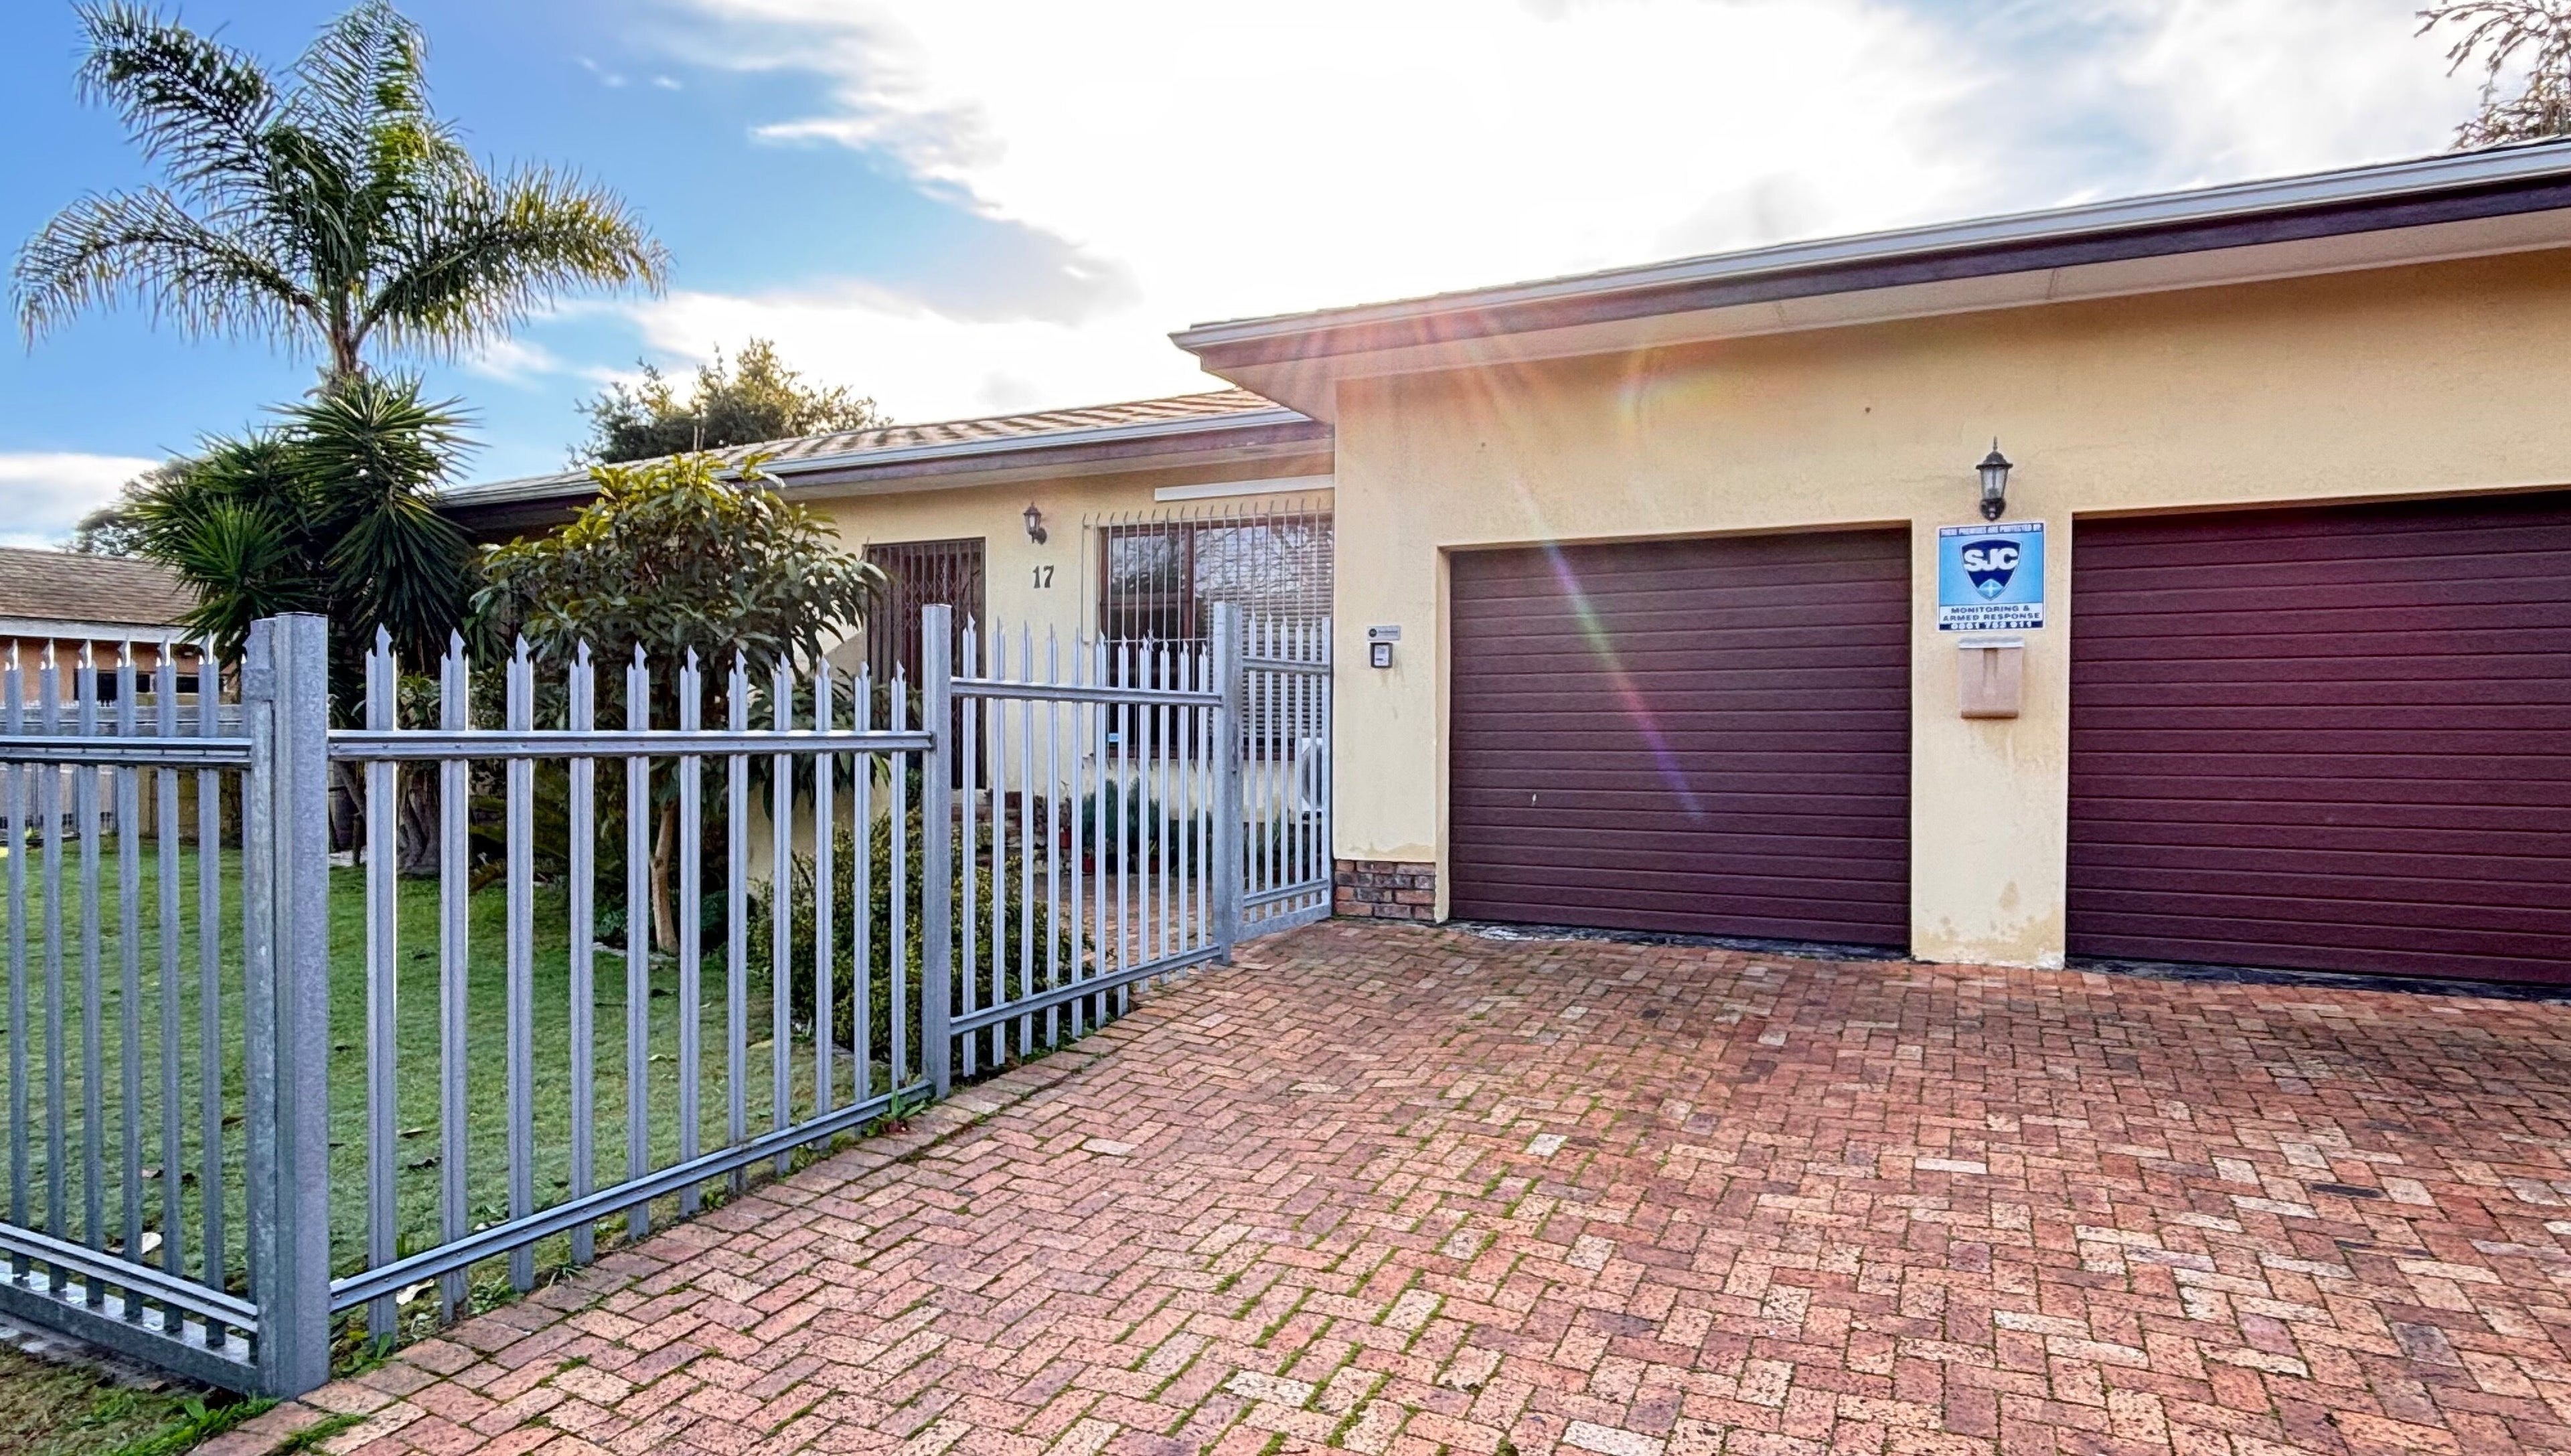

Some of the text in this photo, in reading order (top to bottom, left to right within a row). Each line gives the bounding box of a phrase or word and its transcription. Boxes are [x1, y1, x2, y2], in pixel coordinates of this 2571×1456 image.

[1964, 548, 2019, 572] SJC
[1032, 564, 1054, 588] 17
[1951, 605, 2019, 614] MONITORING
[1983, 613, 2040, 621] RESPONSE
